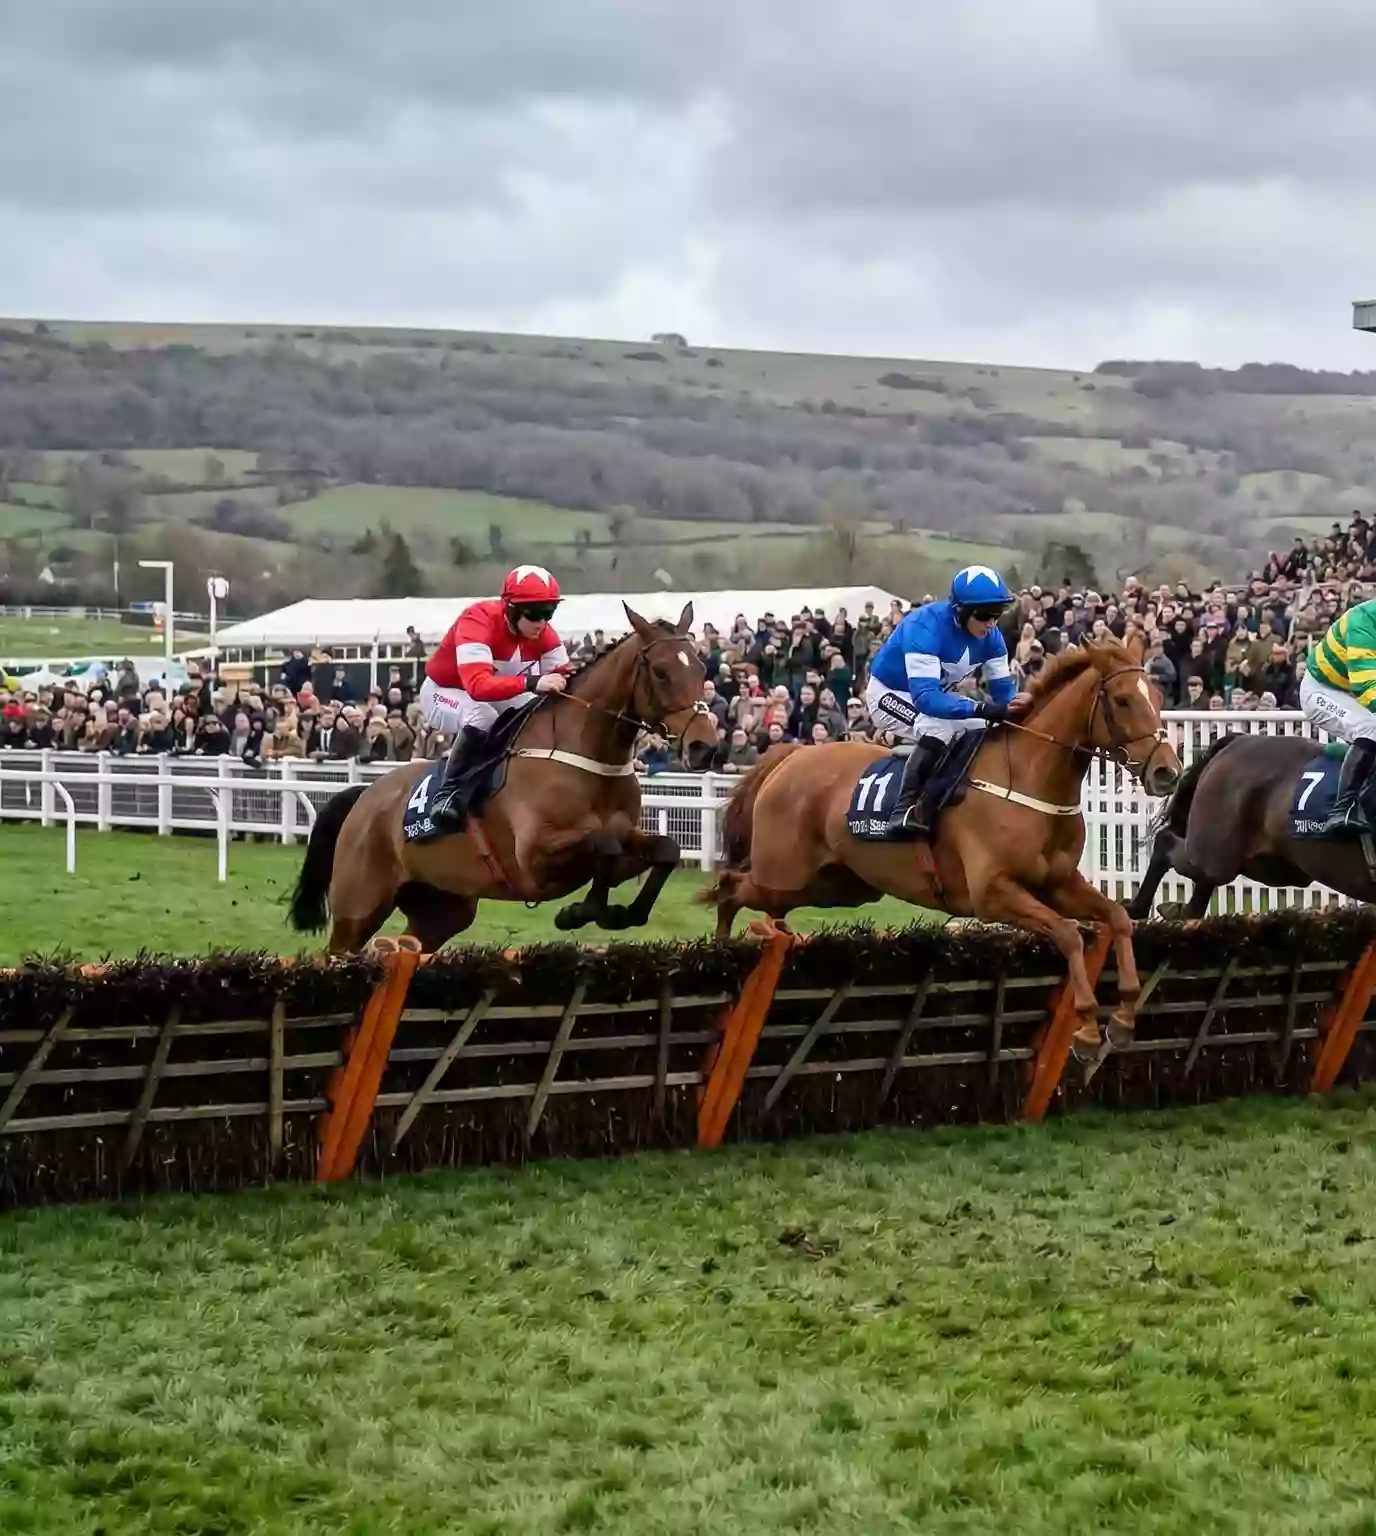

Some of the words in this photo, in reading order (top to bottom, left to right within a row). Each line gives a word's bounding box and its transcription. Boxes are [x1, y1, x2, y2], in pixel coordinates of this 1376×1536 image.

[408, 774, 433, 814] 4
[857, 772, 894, 811] 11
[1297, 771, 1325, 811] 7
